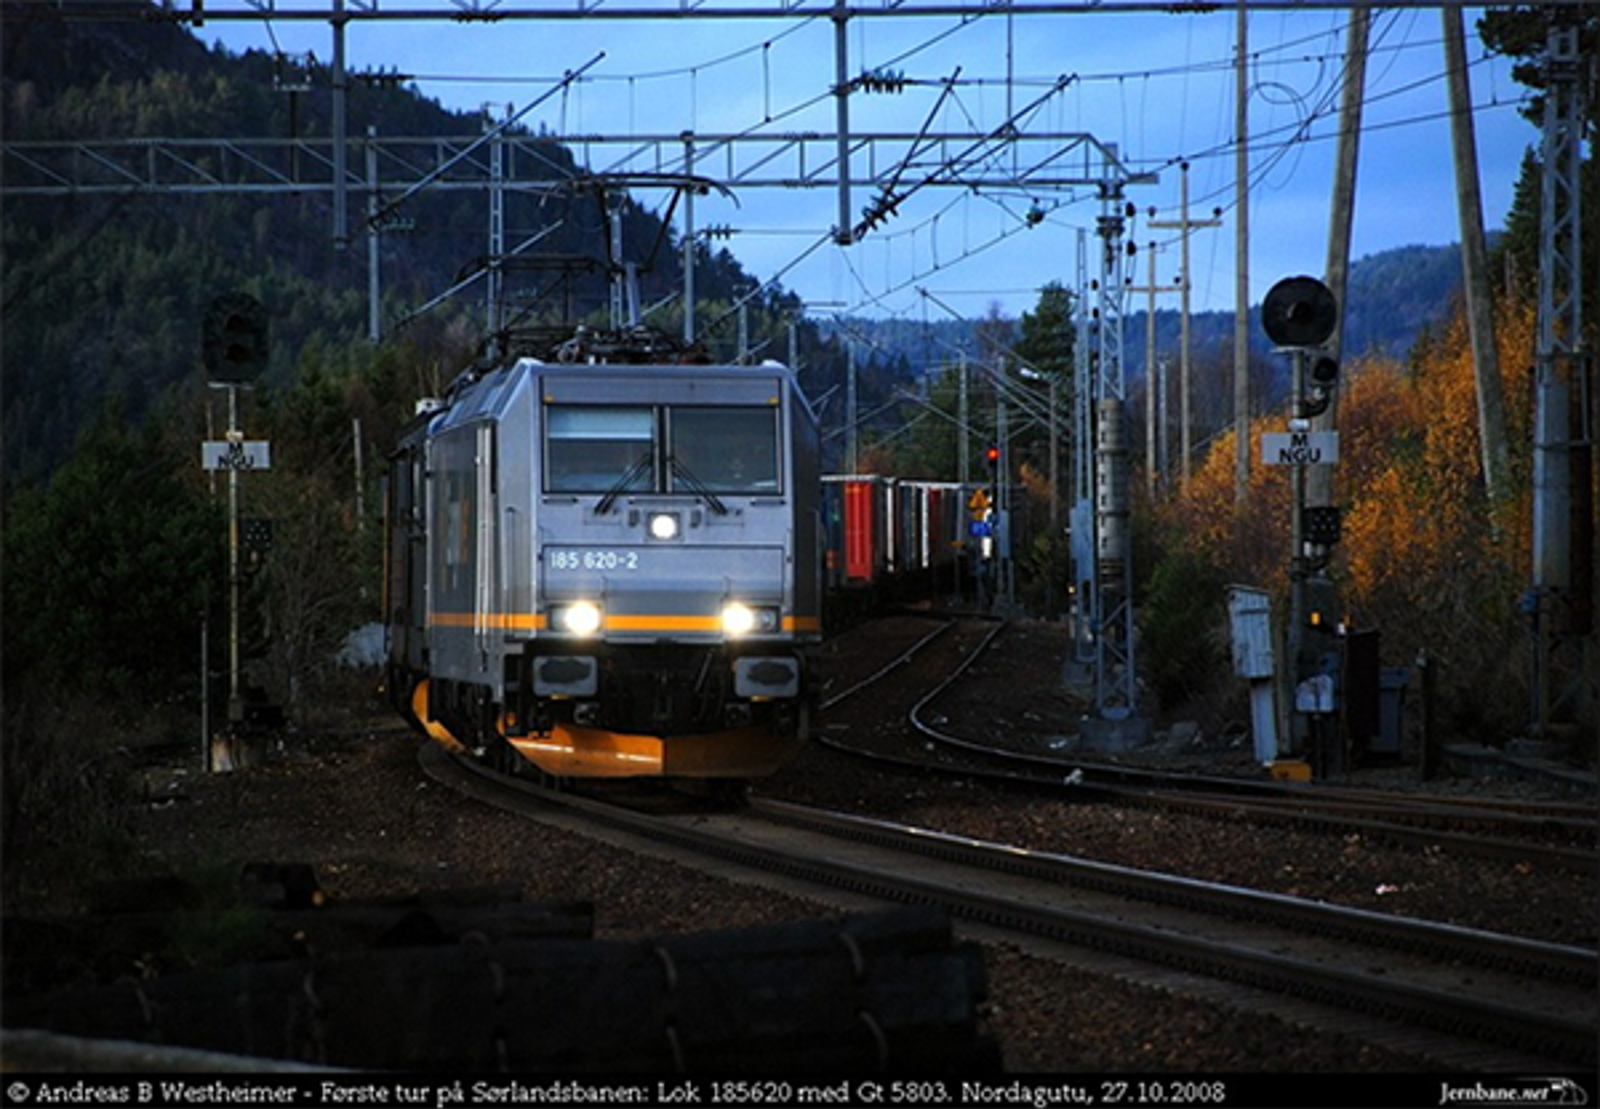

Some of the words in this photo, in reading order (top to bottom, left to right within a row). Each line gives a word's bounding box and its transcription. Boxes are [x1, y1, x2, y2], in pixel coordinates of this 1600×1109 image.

[1291, 433, 1308, 446] M
[229, 442, 243, 454] M
[1279, 447, 1321, 463] NGU
[551, 551, 579, 569] 185
[583, 551, 638, 569] 620-2
